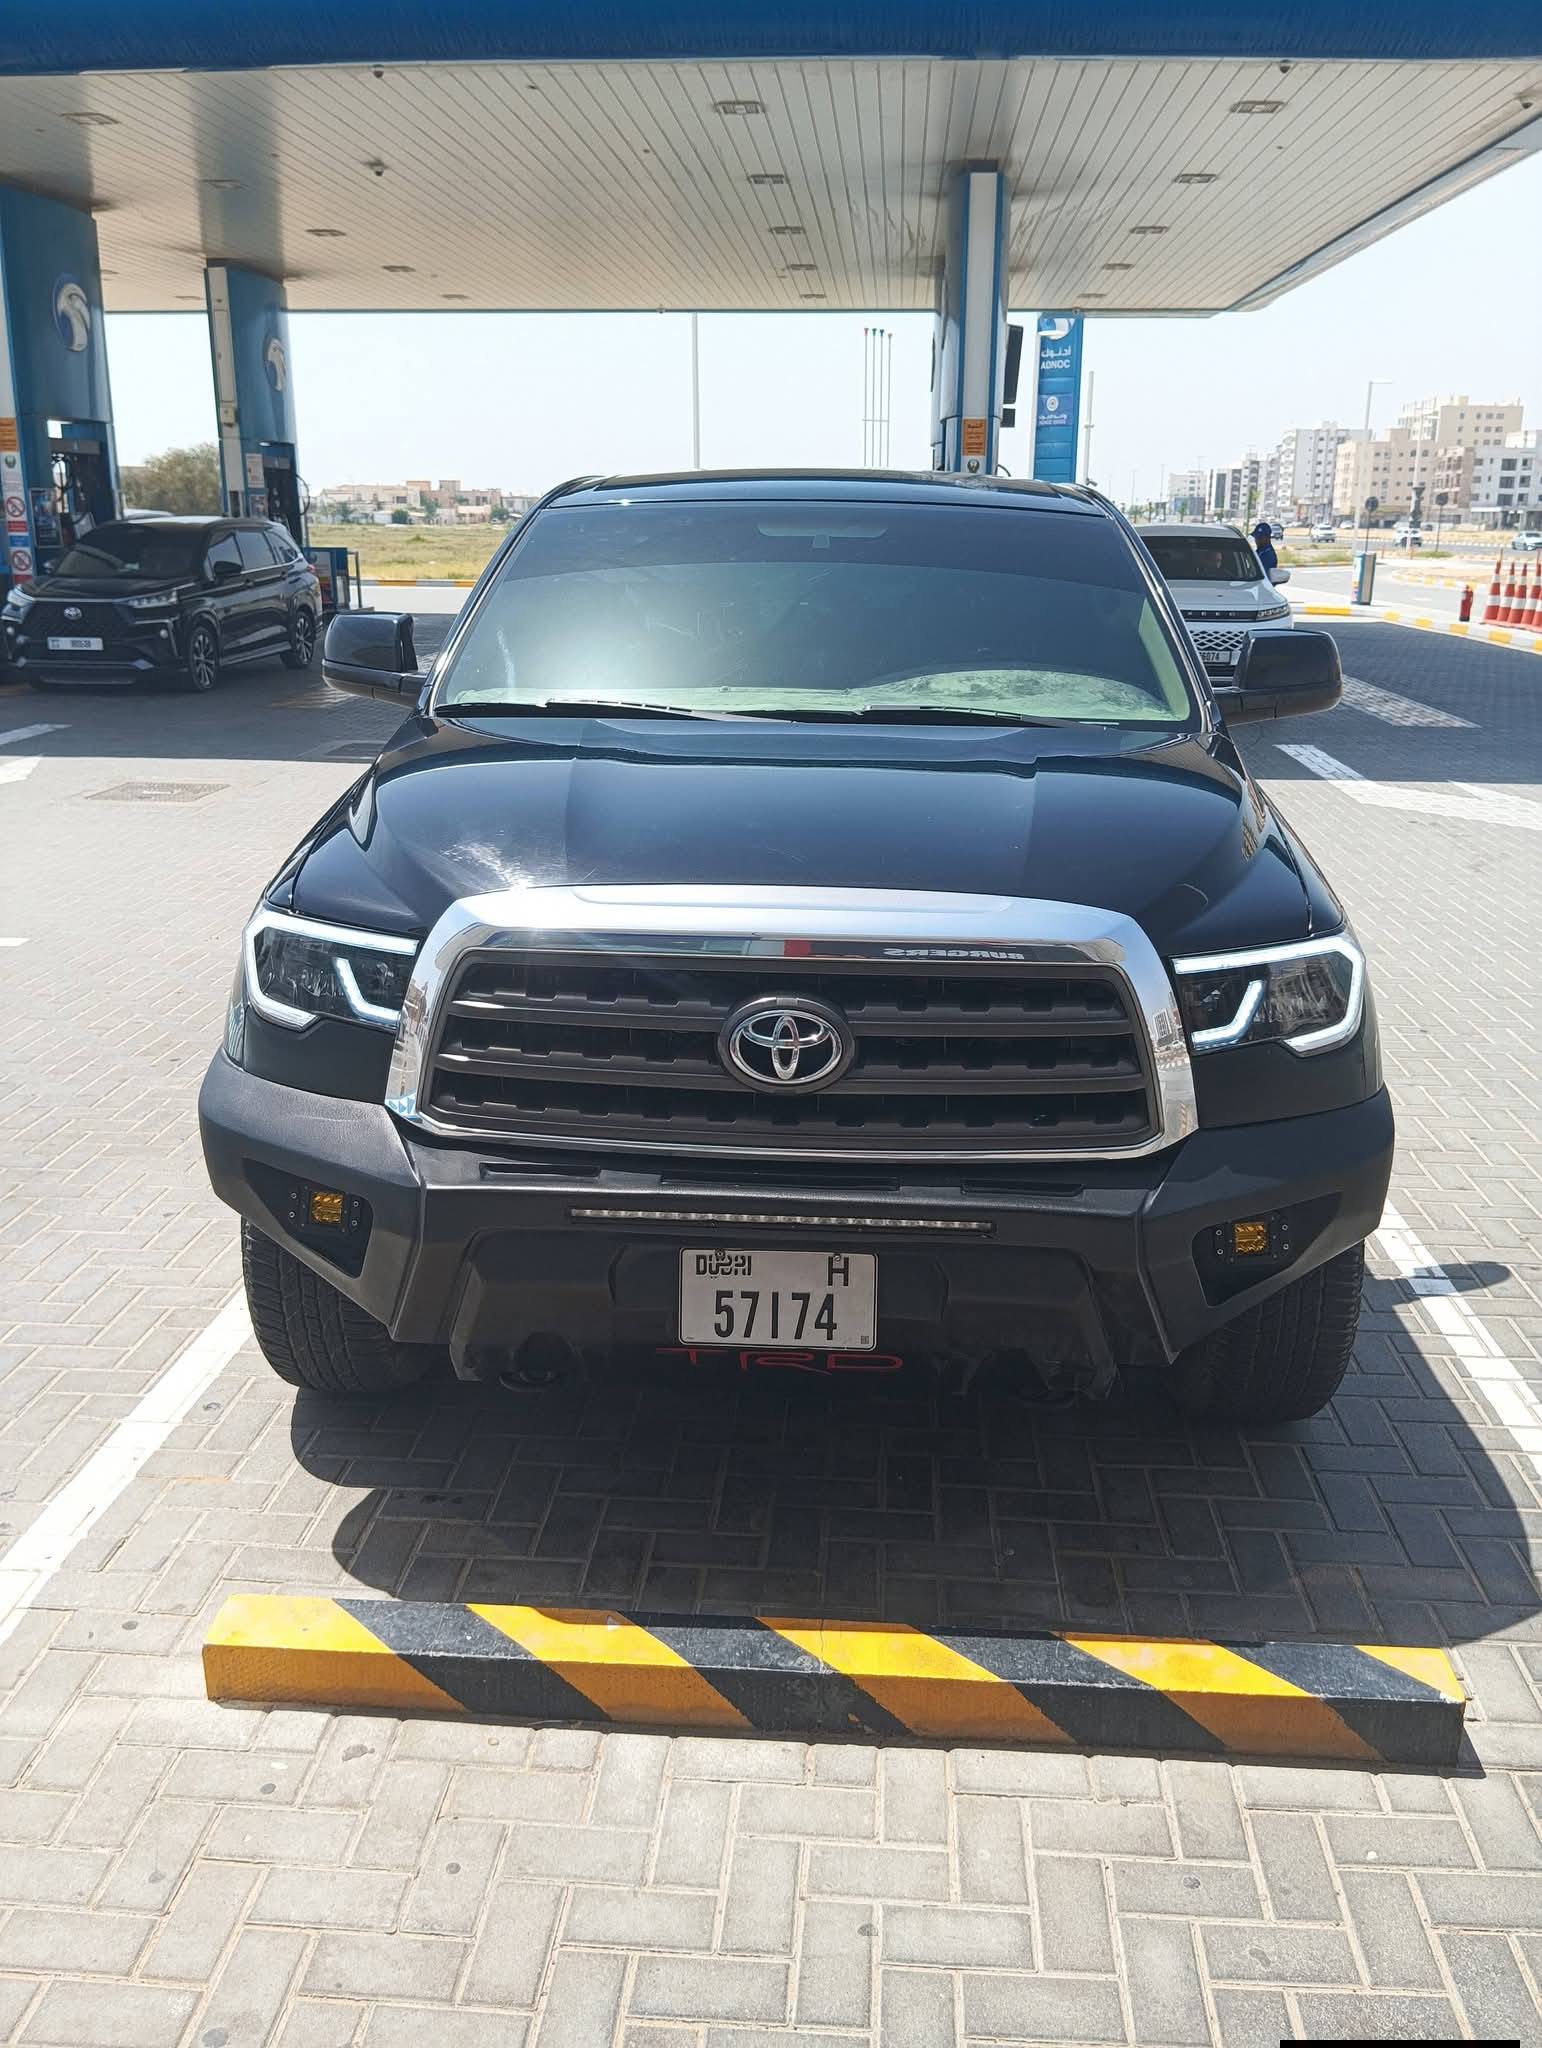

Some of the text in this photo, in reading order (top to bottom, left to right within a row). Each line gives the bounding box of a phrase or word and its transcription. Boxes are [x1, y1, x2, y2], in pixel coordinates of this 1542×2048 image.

[1040, 360, 1071, 369] ADNOC
[828, 1255, 849, 1286] H
[714, 1290, 837, 1340] 57174
[656, 1347, 903, 1376] TRD
